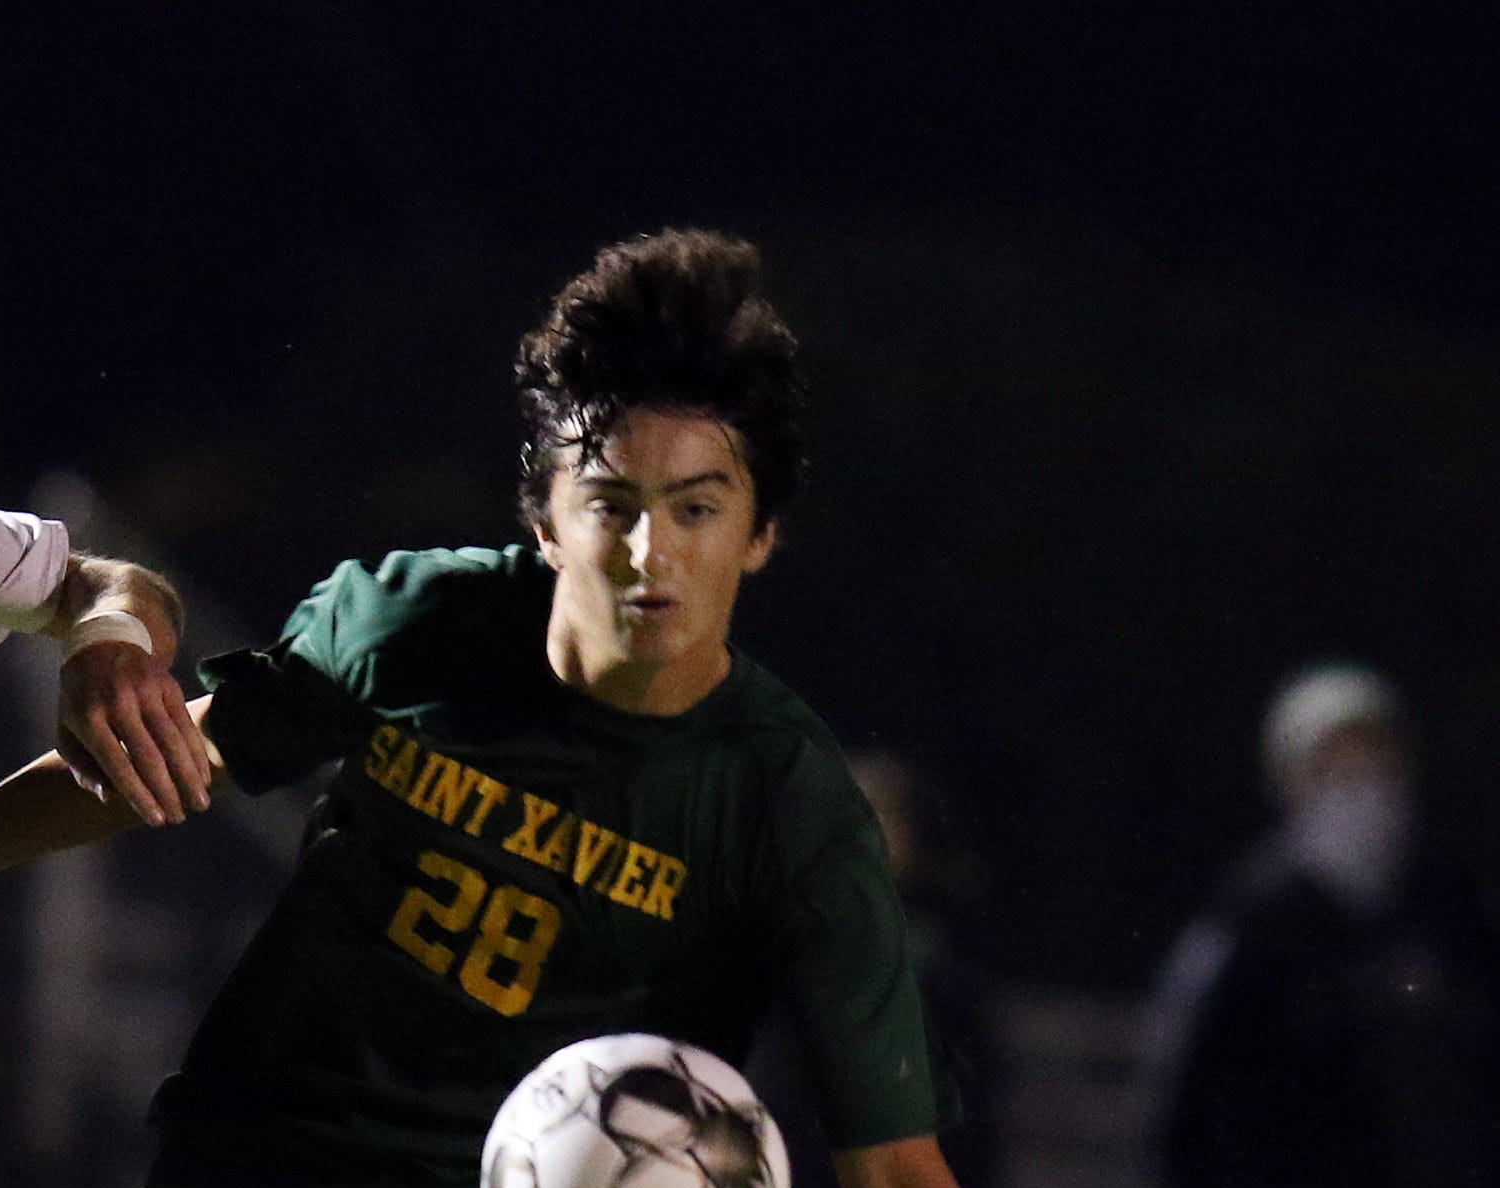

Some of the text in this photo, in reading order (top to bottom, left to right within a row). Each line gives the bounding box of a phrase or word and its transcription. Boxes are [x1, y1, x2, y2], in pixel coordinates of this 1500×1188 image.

[363, 724, 689, 922] SAINT XAVIER
[387, 851, 562, 1017] 28
